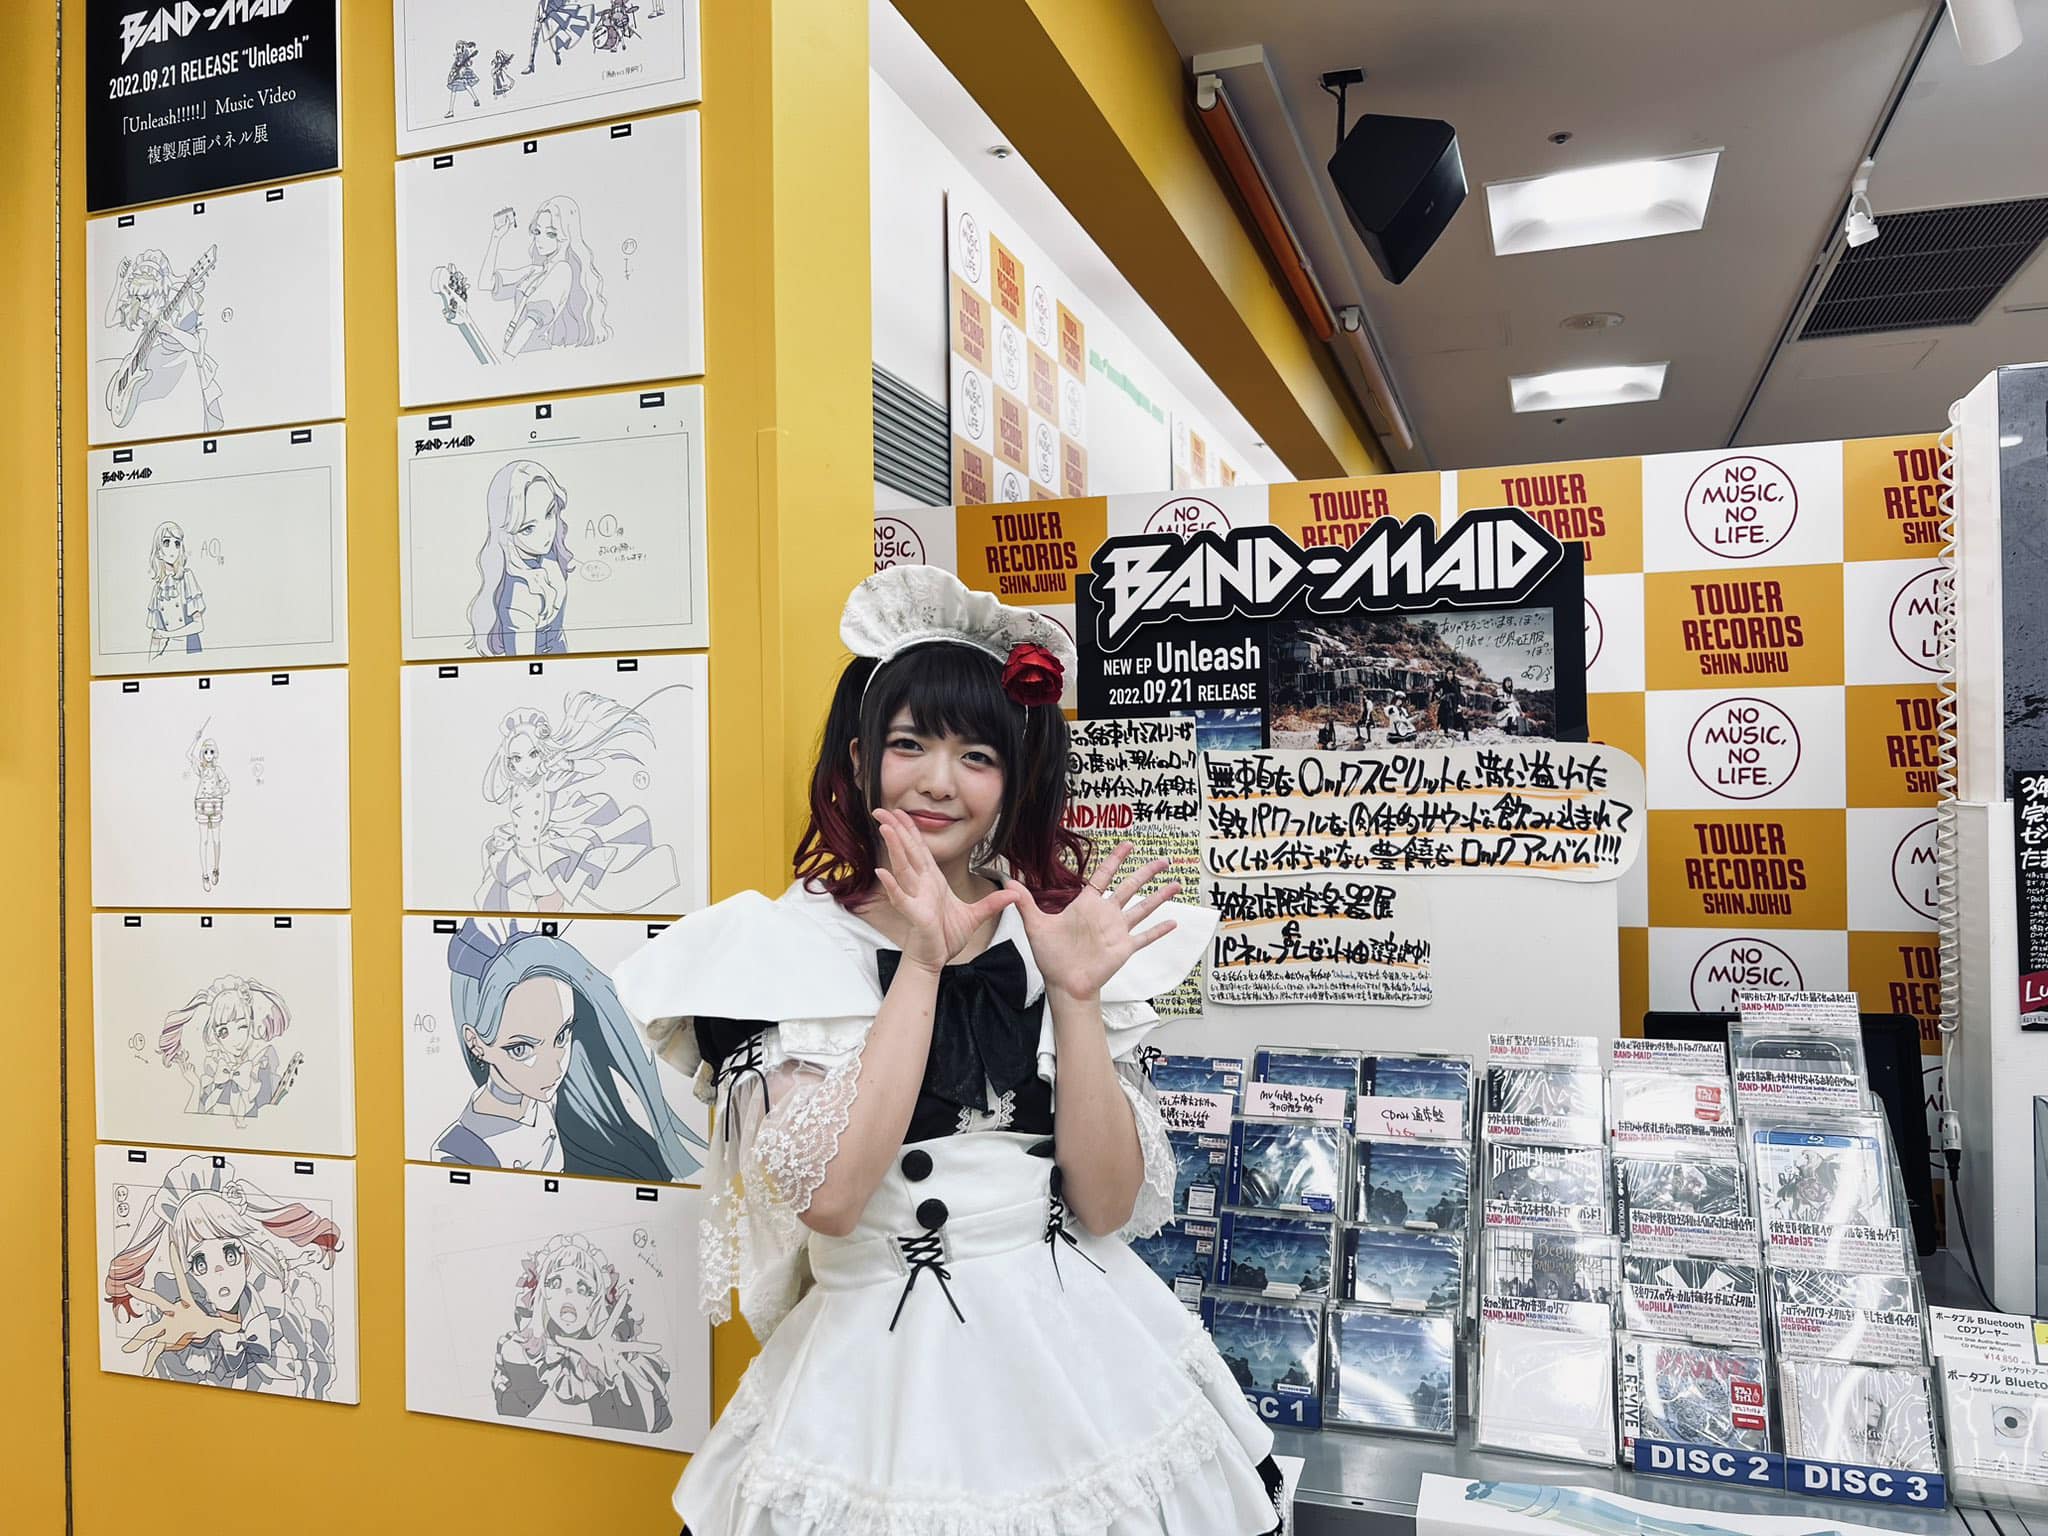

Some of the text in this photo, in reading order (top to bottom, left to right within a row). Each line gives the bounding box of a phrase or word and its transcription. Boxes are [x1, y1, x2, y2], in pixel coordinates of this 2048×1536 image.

[109, 64, 177, 100] 2022.09.21
[180, 50, 240, 85] RELEASE
[215, 93, 255, 116] Music
[257, 85, 297, 107] Video
[146, 124, 269, 165] 複製原画パネル展
[1725, 466, 1756, 483] NO
[1501, 474, 1587, 507] TOWER
[1702, 483, 1784, 504] MUSIC,
[1174, 505, 1201, 522] NO
[1309, 488, 1390, 522] TOWER
[1725, 506, 1757, 523] NO
[991, 511, 1063, 542] TOWER
[1714, 525, 1770, 545] LIFE.
[874, 540, 916, 558] USIC,
[985, 541, 1079, 574] RECORDS
[999, 573, 1068, 595] SHINJUKU
[1102, 519, 1548, 640] BAND-MAID
[1690, 580, 1784, 616] TOWER
[1682, 615, 1804, 651] RECORDS
[1103, 638, 1261, 676] NEW EP Unleash
[1700, 651, 1790, 675] SHINJUKU
[1109, 677, 1257, 705] 2022.09.21 RELEASE
[1727, 707, 1760, 725] NO
[1705, 726, 1787, 746] MUSIC,
[1728, 748, 1760, 765] NO
[1717, 767, 1773, 786] LIFE.
[1060, 803, 1134, 829] AND-MAID
[1693, 823, 1787, 856] TOWER
[1685, 858, 1807, 891] RECORDS
[1703, 893, 1792, 916] SHINJUKU
[1730, 948, 1763, 964] NO
[1708, 966, 1791, 987] MUSIC,
[1741, 1002, 1785, 1011] BAND-MAID
[1737, 1082, 1783, 1093] BAND-MAID
[1632, 1224, 1674, 1236] BAND-MAID
[1483, 1309, 1526, 1322] BAND-MAID
[1977, 1317, 2025, 1330] Bluetooth
[1289, 1399, 1304, 1422] 1
[1651, 1444, 1770, 1481] DISC 2
[1804, 1464, 1929, 1501] DISC 3
